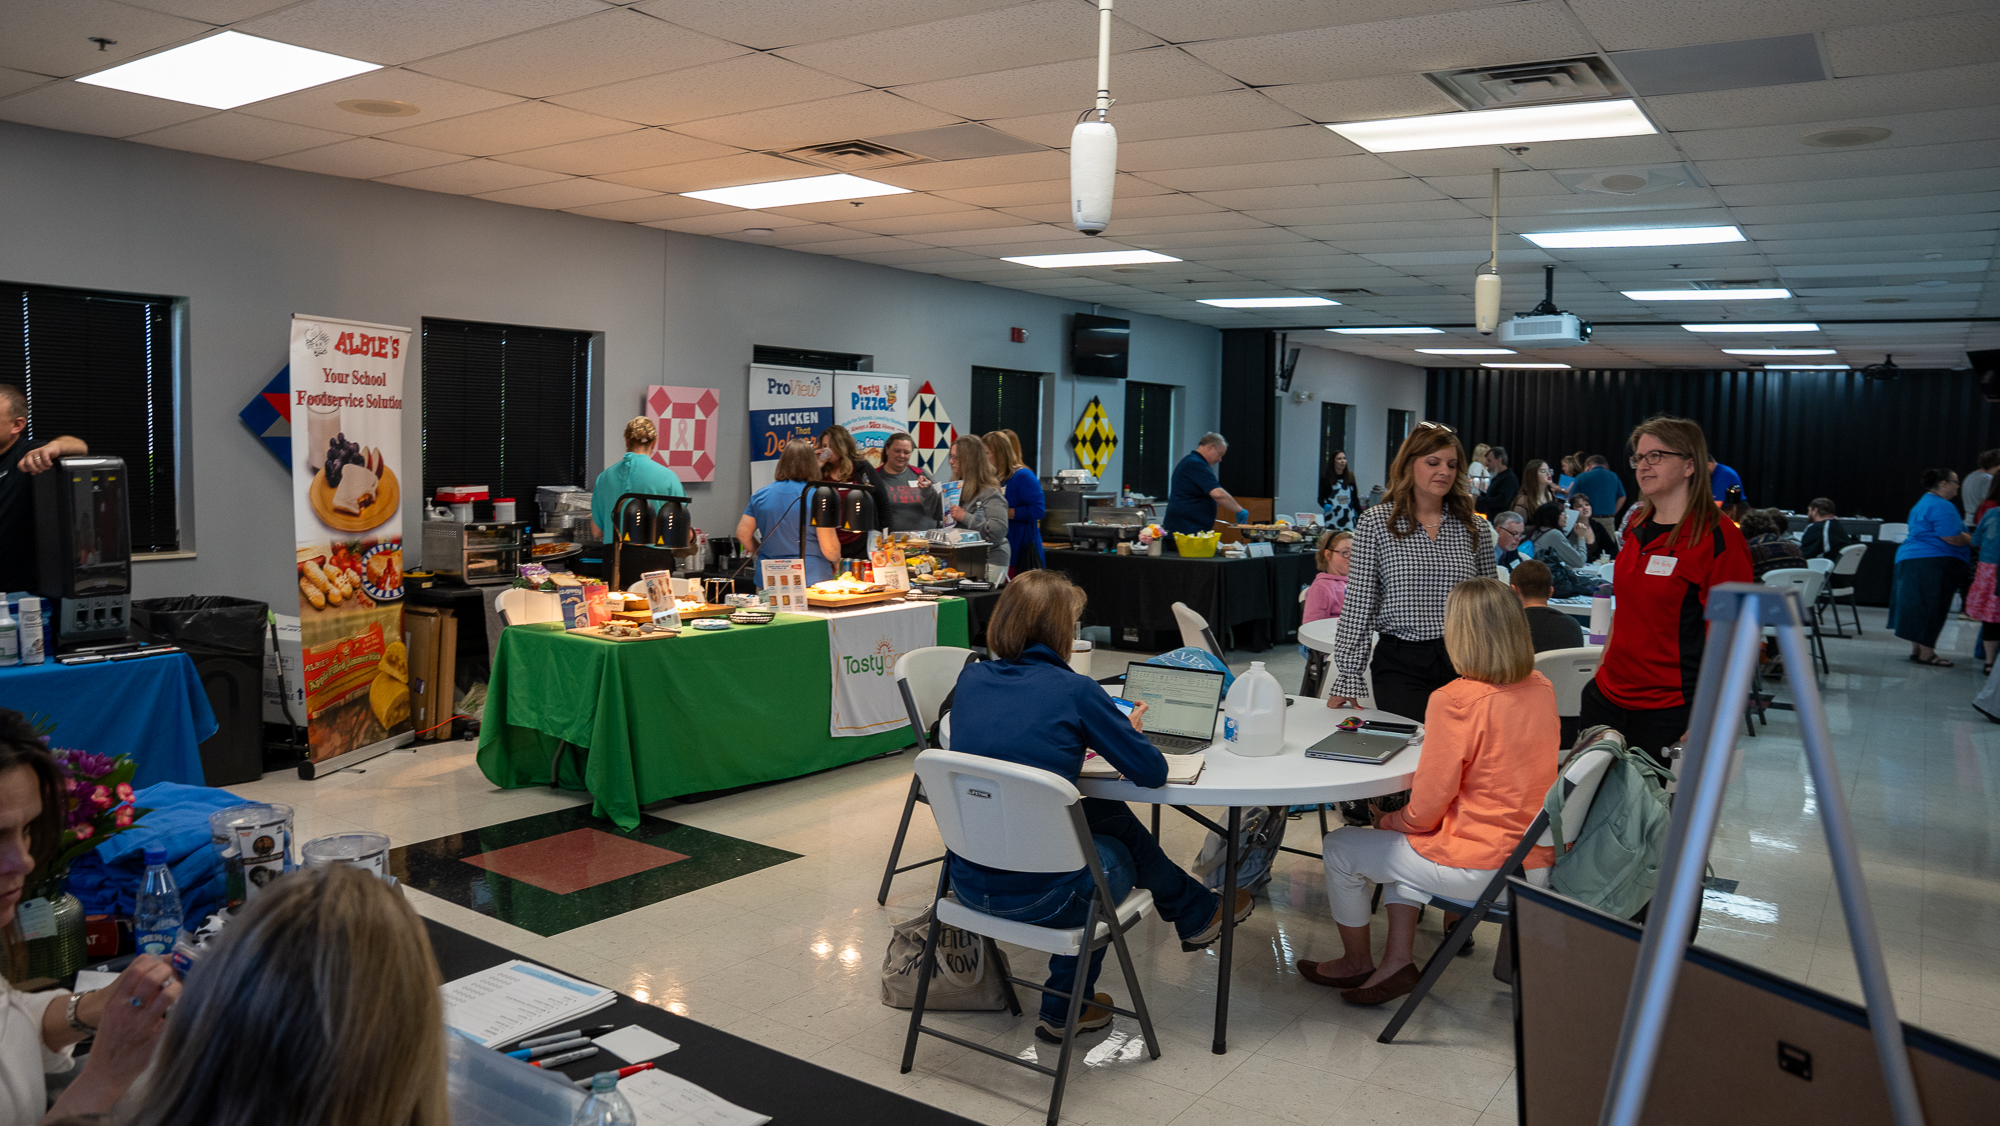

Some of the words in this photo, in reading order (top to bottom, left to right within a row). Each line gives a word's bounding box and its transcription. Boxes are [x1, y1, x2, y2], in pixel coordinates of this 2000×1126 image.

[334, 331, 400, 359] ALBIE'S
[322, 368, 350, 384] Your
[352, 370, 387, 387] School
[767, 377, 820, 398] ProView
[857, 384, 880, 397] Tasty
[295, 390, 364, 408] Foodservice
[851, 392, 889, 411] Pizza
[768, 411, 819, 426] CHICKEN
[869, 421, 882, 429] Slice
[795, 426, 811, 435] That
[864, 437, 885, 448] Grain
